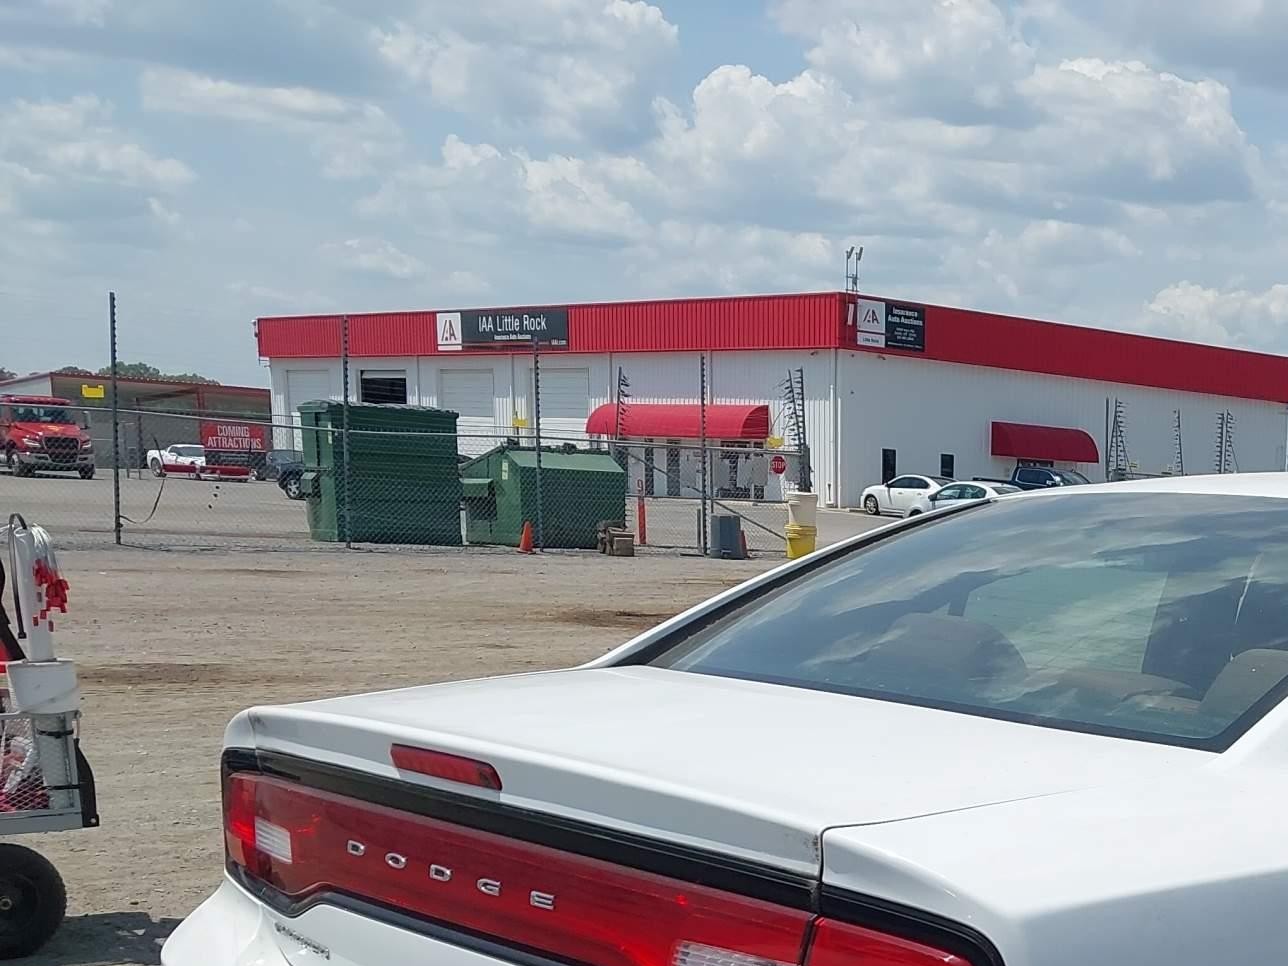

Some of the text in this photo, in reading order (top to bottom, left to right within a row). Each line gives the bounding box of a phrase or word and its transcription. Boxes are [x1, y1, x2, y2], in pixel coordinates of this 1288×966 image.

[479, 314, 547, 332] IAA Little Rock
[217, 425, 250, 438] COMING
[207, 436, 262, 449] ATTRACTIONS
[772, 461, 785, 469] STOP
[347, 839, 555, 911] DODGE
